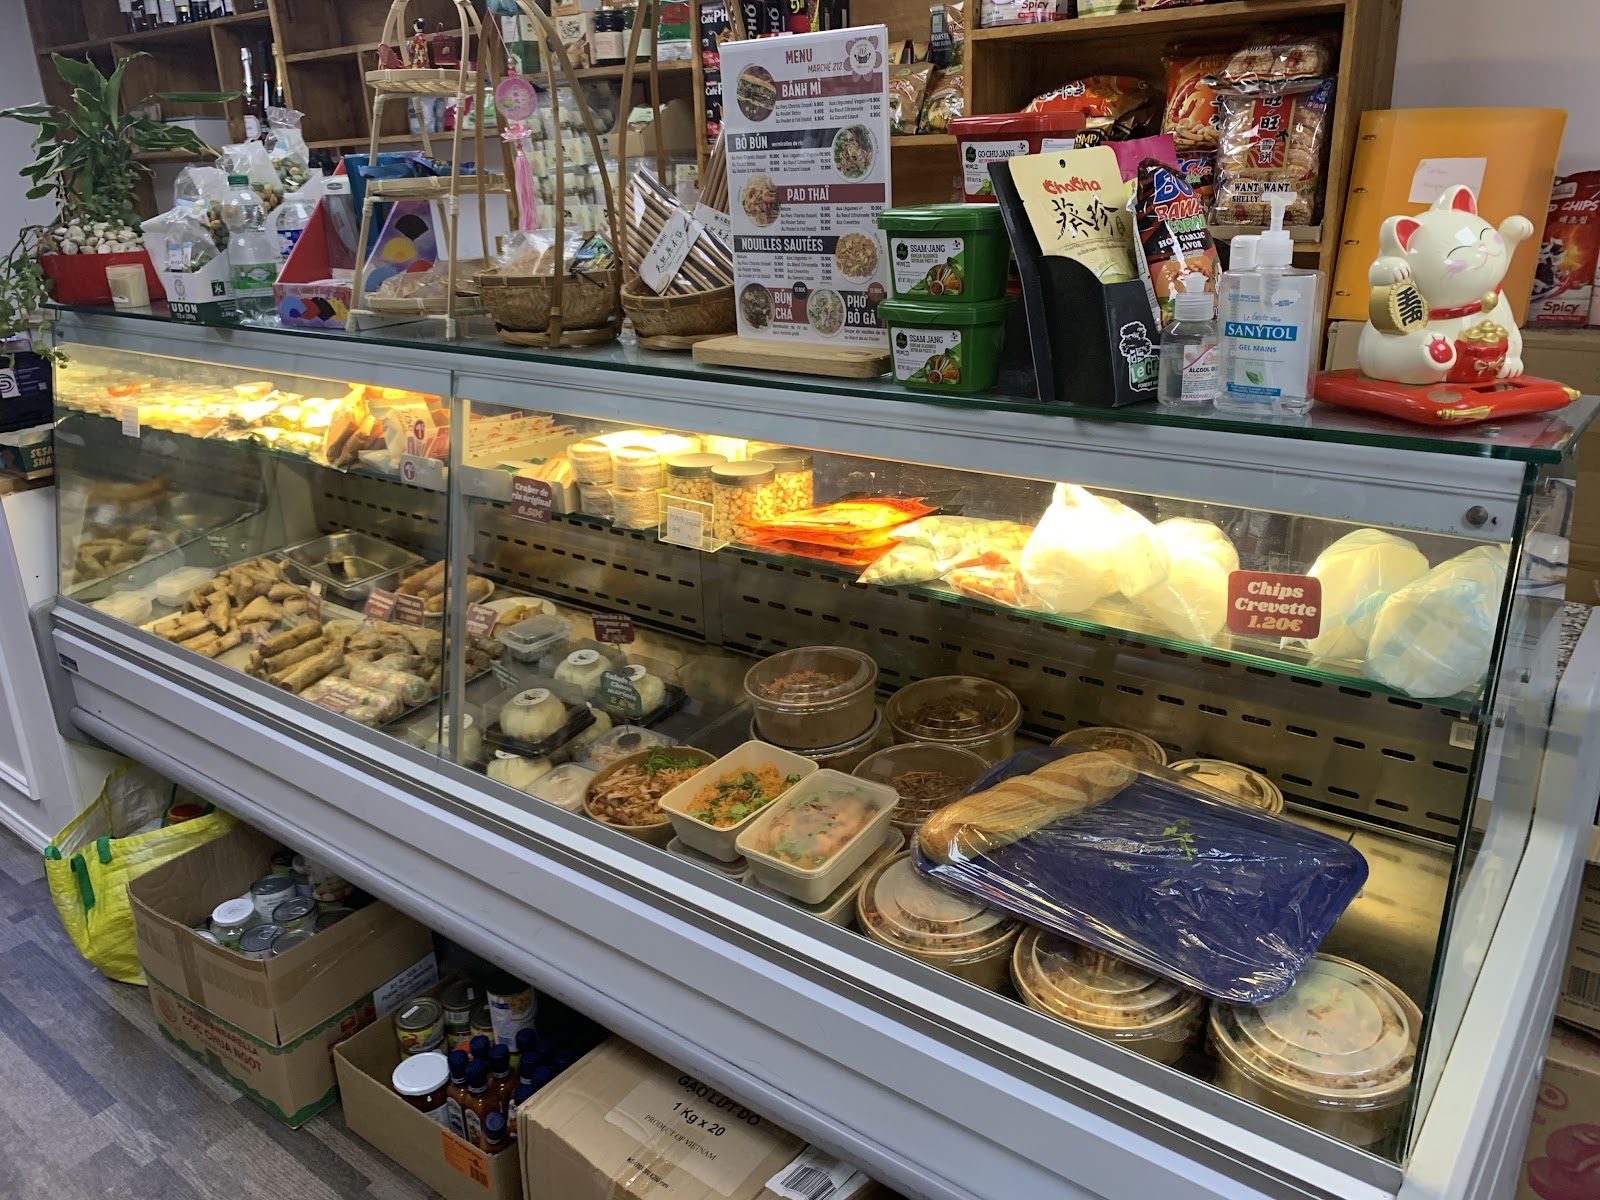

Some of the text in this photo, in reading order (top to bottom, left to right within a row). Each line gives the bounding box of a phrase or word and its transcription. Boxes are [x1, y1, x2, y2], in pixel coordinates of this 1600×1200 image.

[714, 8, 729, 23] PH
[785, 48, 813, 64] MENU
[808, 61, 843, 73] MARCHÉ 212
[782, 81, 807, 98] BÁNH
[749, 132, 768, 149] BÚN
[787, 185, 830, 201] PAD THAÏ
[1234, 182, 1290, 193] WANT WANT
[1232, 195, 1260, 203] SHELLY
[1561, 200, 1590, 212] CHIPS
[742, 234, 824, 252] NOUILLES SAUTÉES
[171, 303, 198, 314] UDON
[1542, 301, 1580, 316] Spicy
[1228, 323, 1293, 340] SANYTOL
[1252, 345, 1277, 353] MAINS
[30, 447, 53, 458] SESA
[33, 458, 52, 468] SNA
[1247, 581, 1305, 600] Chips
[1234, 597, 1318, 617] Crevette
[1247, 615, 1303, 632] 1.20€
[672, 1102, 726, 1137] 1 Kg x 20
[644, 1113, 717, 1161] PRODUCT OF VIETNAM
